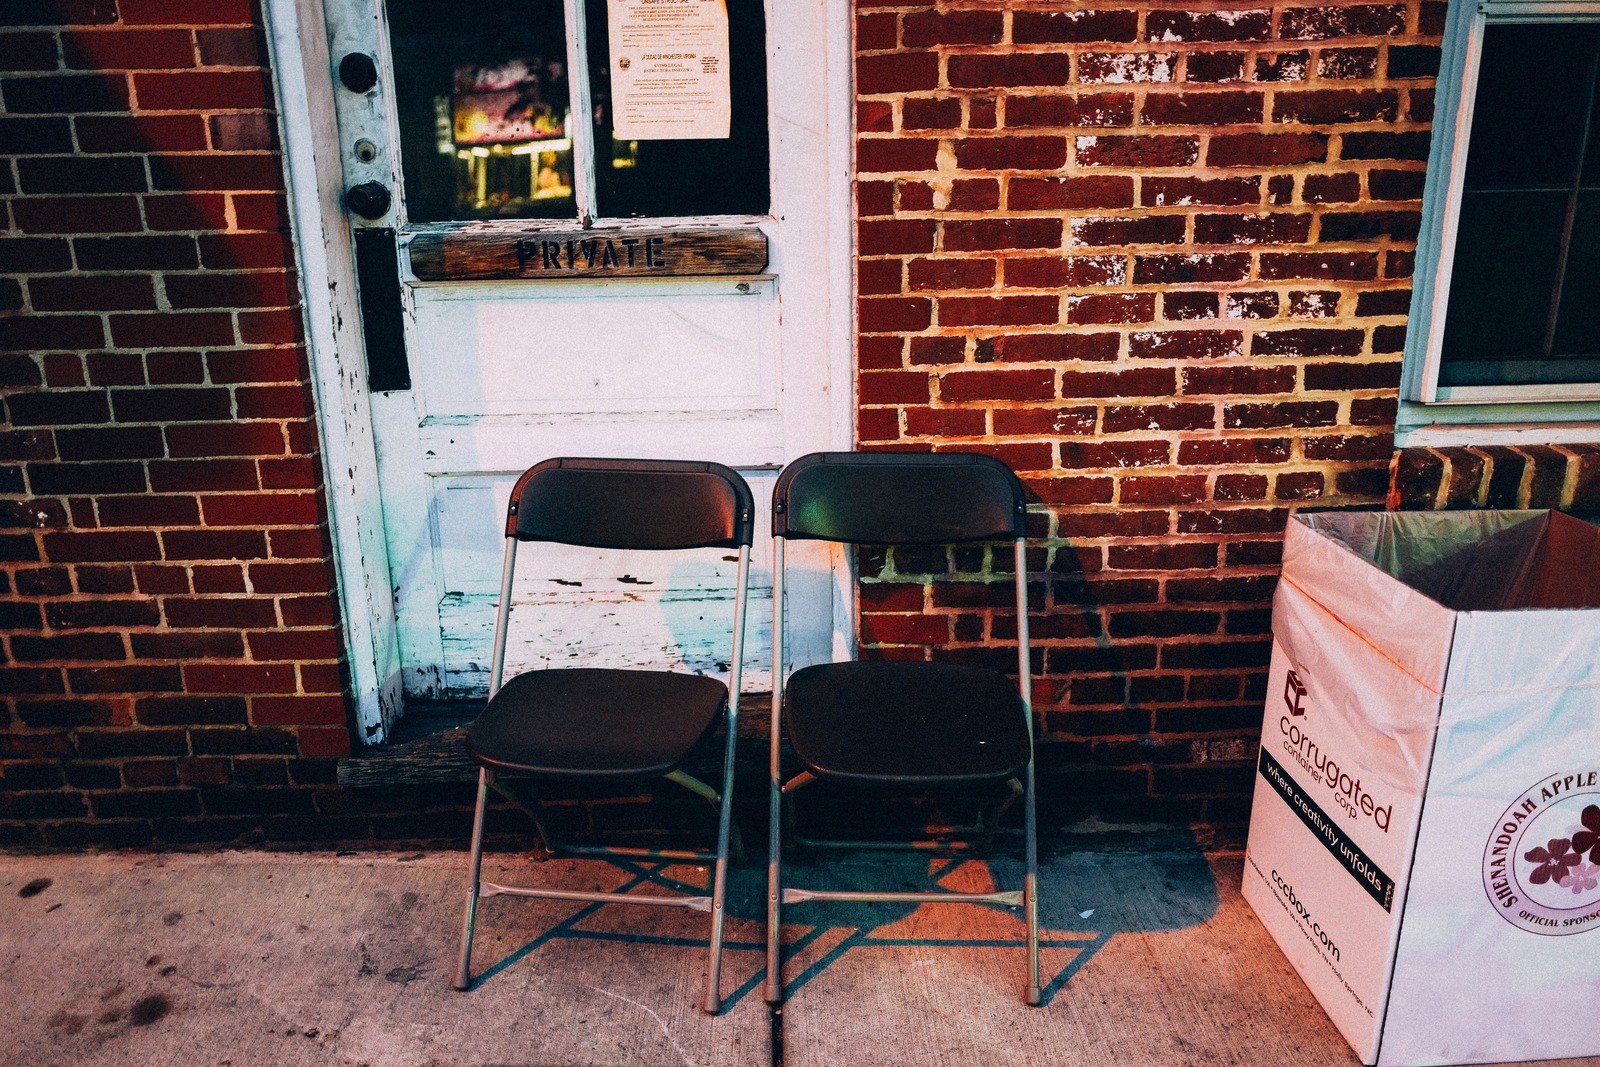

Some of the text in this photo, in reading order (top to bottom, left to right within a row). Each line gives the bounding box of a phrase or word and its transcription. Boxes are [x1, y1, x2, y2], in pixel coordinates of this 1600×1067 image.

[516, 237, 666, 272] PRIVATE
[1280, 716, 1392, 833] corrugated
[1283, 740, 1358, 821] container corp.
[1267, 762, 1382, 892] where creativity unfolds
[1490, 771, 1598, 908] SHENANDOAH APPLE
[1271, 869, 1340, 962] cccbox.com
[1519, 909, 1560, 927] OFFICIAL
[1364, 1005, 1374, 1018] NC
